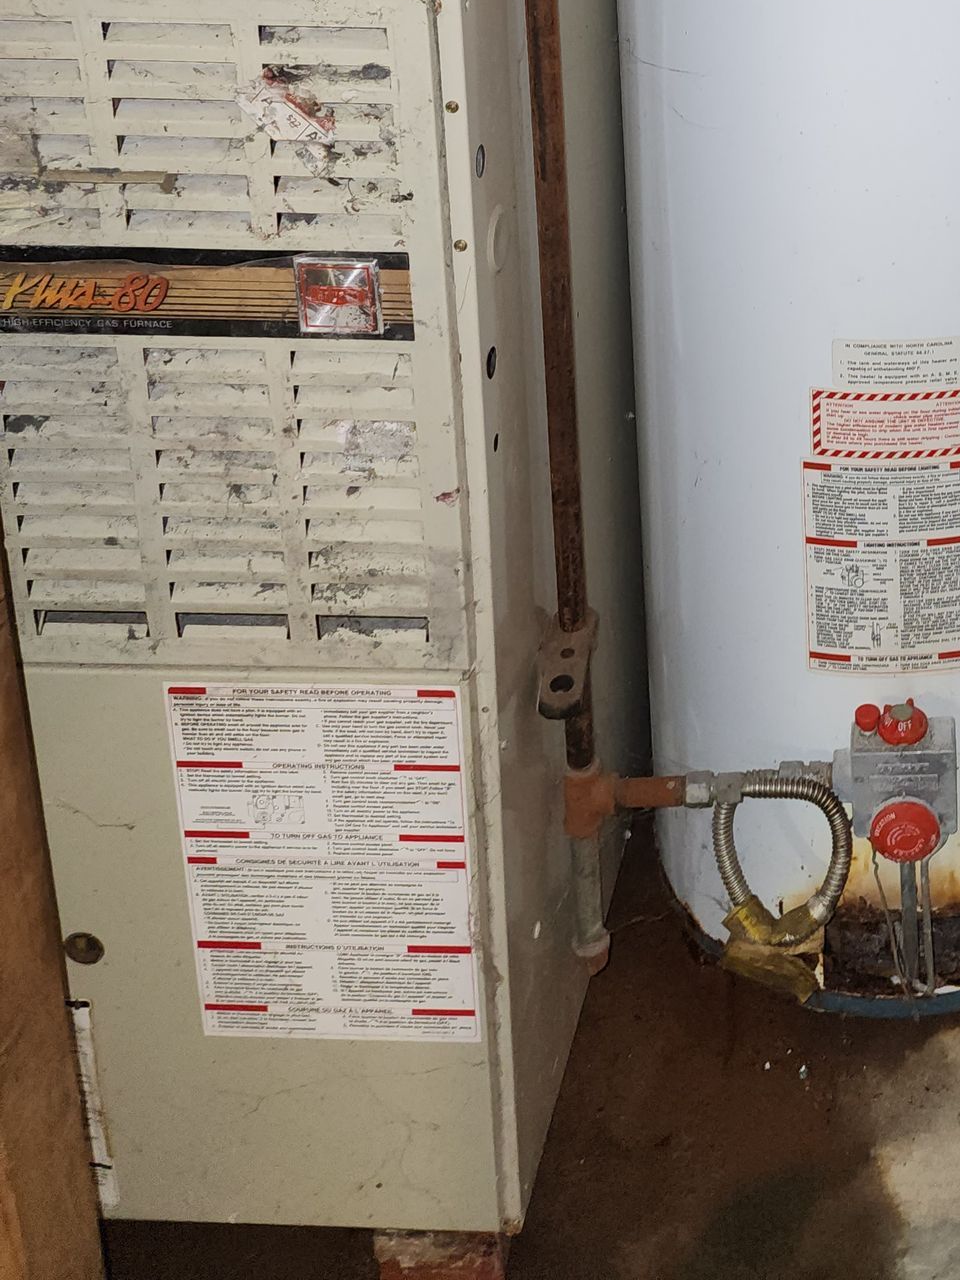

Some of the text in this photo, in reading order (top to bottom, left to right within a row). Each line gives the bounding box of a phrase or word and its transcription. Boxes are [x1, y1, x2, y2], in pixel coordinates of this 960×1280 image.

[112, 272, 169, 312] 80
[97, 319, 118, 328] GAS
[123, 320, 173, 328] FURNACE
[897, 720, 912, 732] OFF
